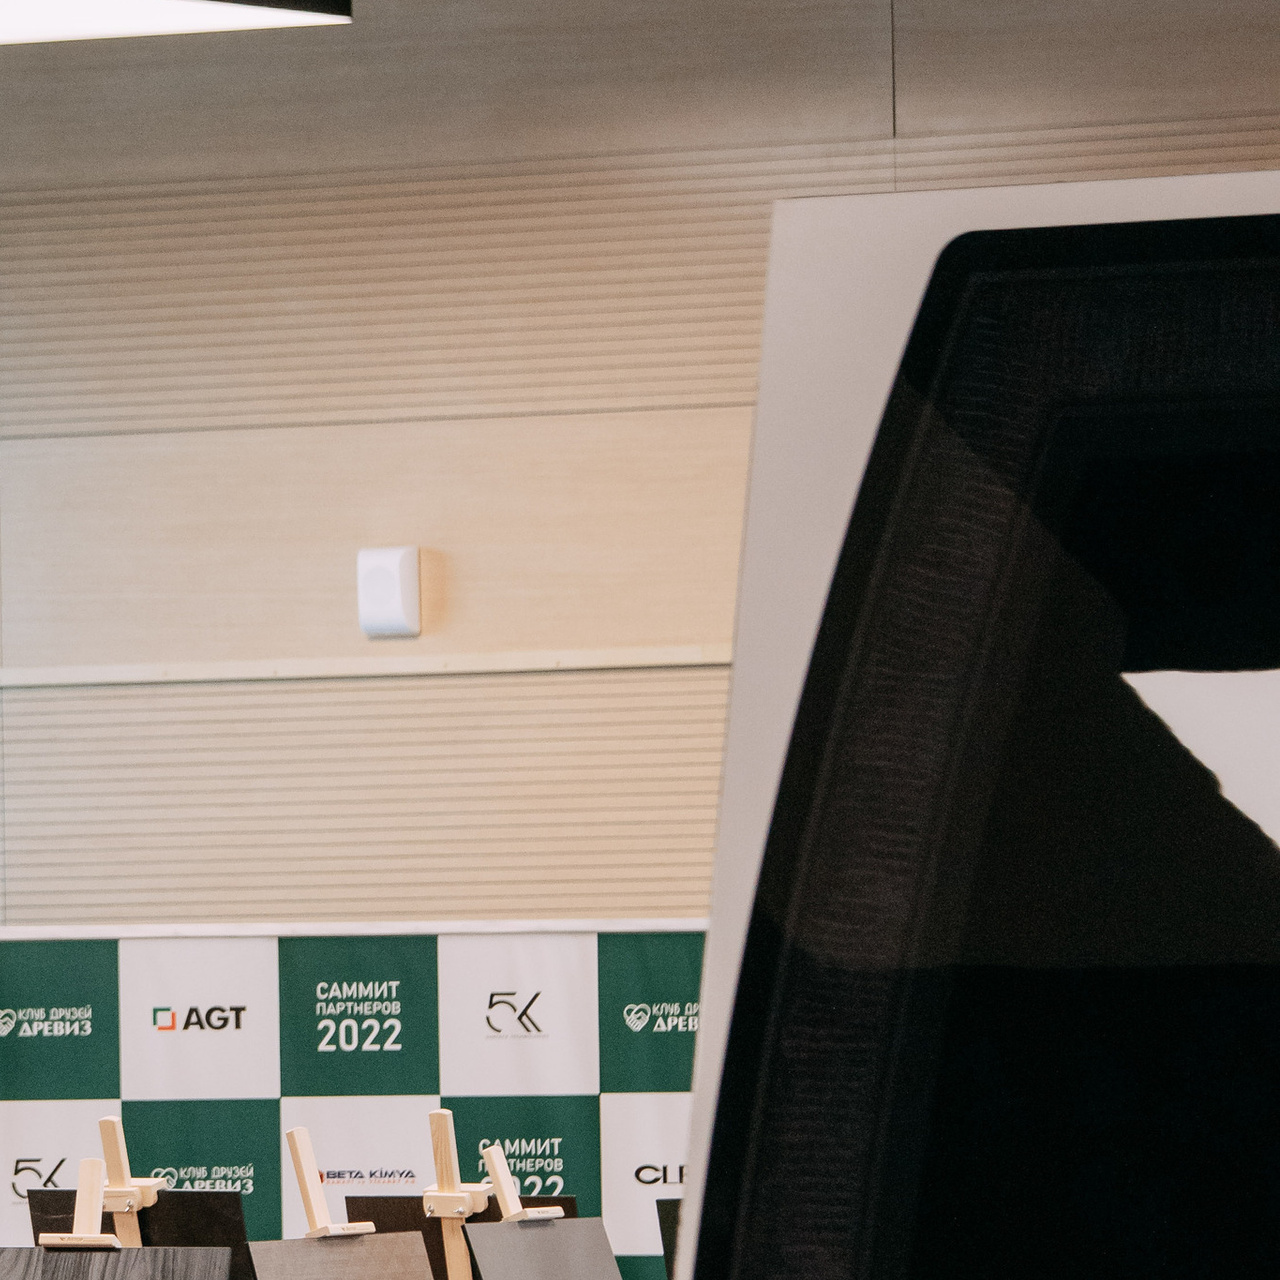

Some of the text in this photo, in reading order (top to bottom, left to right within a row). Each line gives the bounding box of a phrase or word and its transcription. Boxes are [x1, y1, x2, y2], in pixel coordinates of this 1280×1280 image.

[316, 981, 400, 1000] САММИТ
[18, 1004, 93, 1020] КЛУБ ДРУЗЕЙ
[316, 1001, 401, 1016] ПАРТНЕРОВ
[652, 1002, 680, 1017] КЛУБ
[182, 1006, 246, 1031] AGT
[652, 1015, 699, 1032] ДРЕВ
[18, 1020, 93, 1037] ДРЕВИЗ
[317, 1018, 402, 1052] 2022
[179, 1163, 254, 1180] КЛУБ ДРУЗЕЙ
[326, 1169, 364, 1179] BETA
[478, 1158, 564, 1173] ПТНЕРОВ
